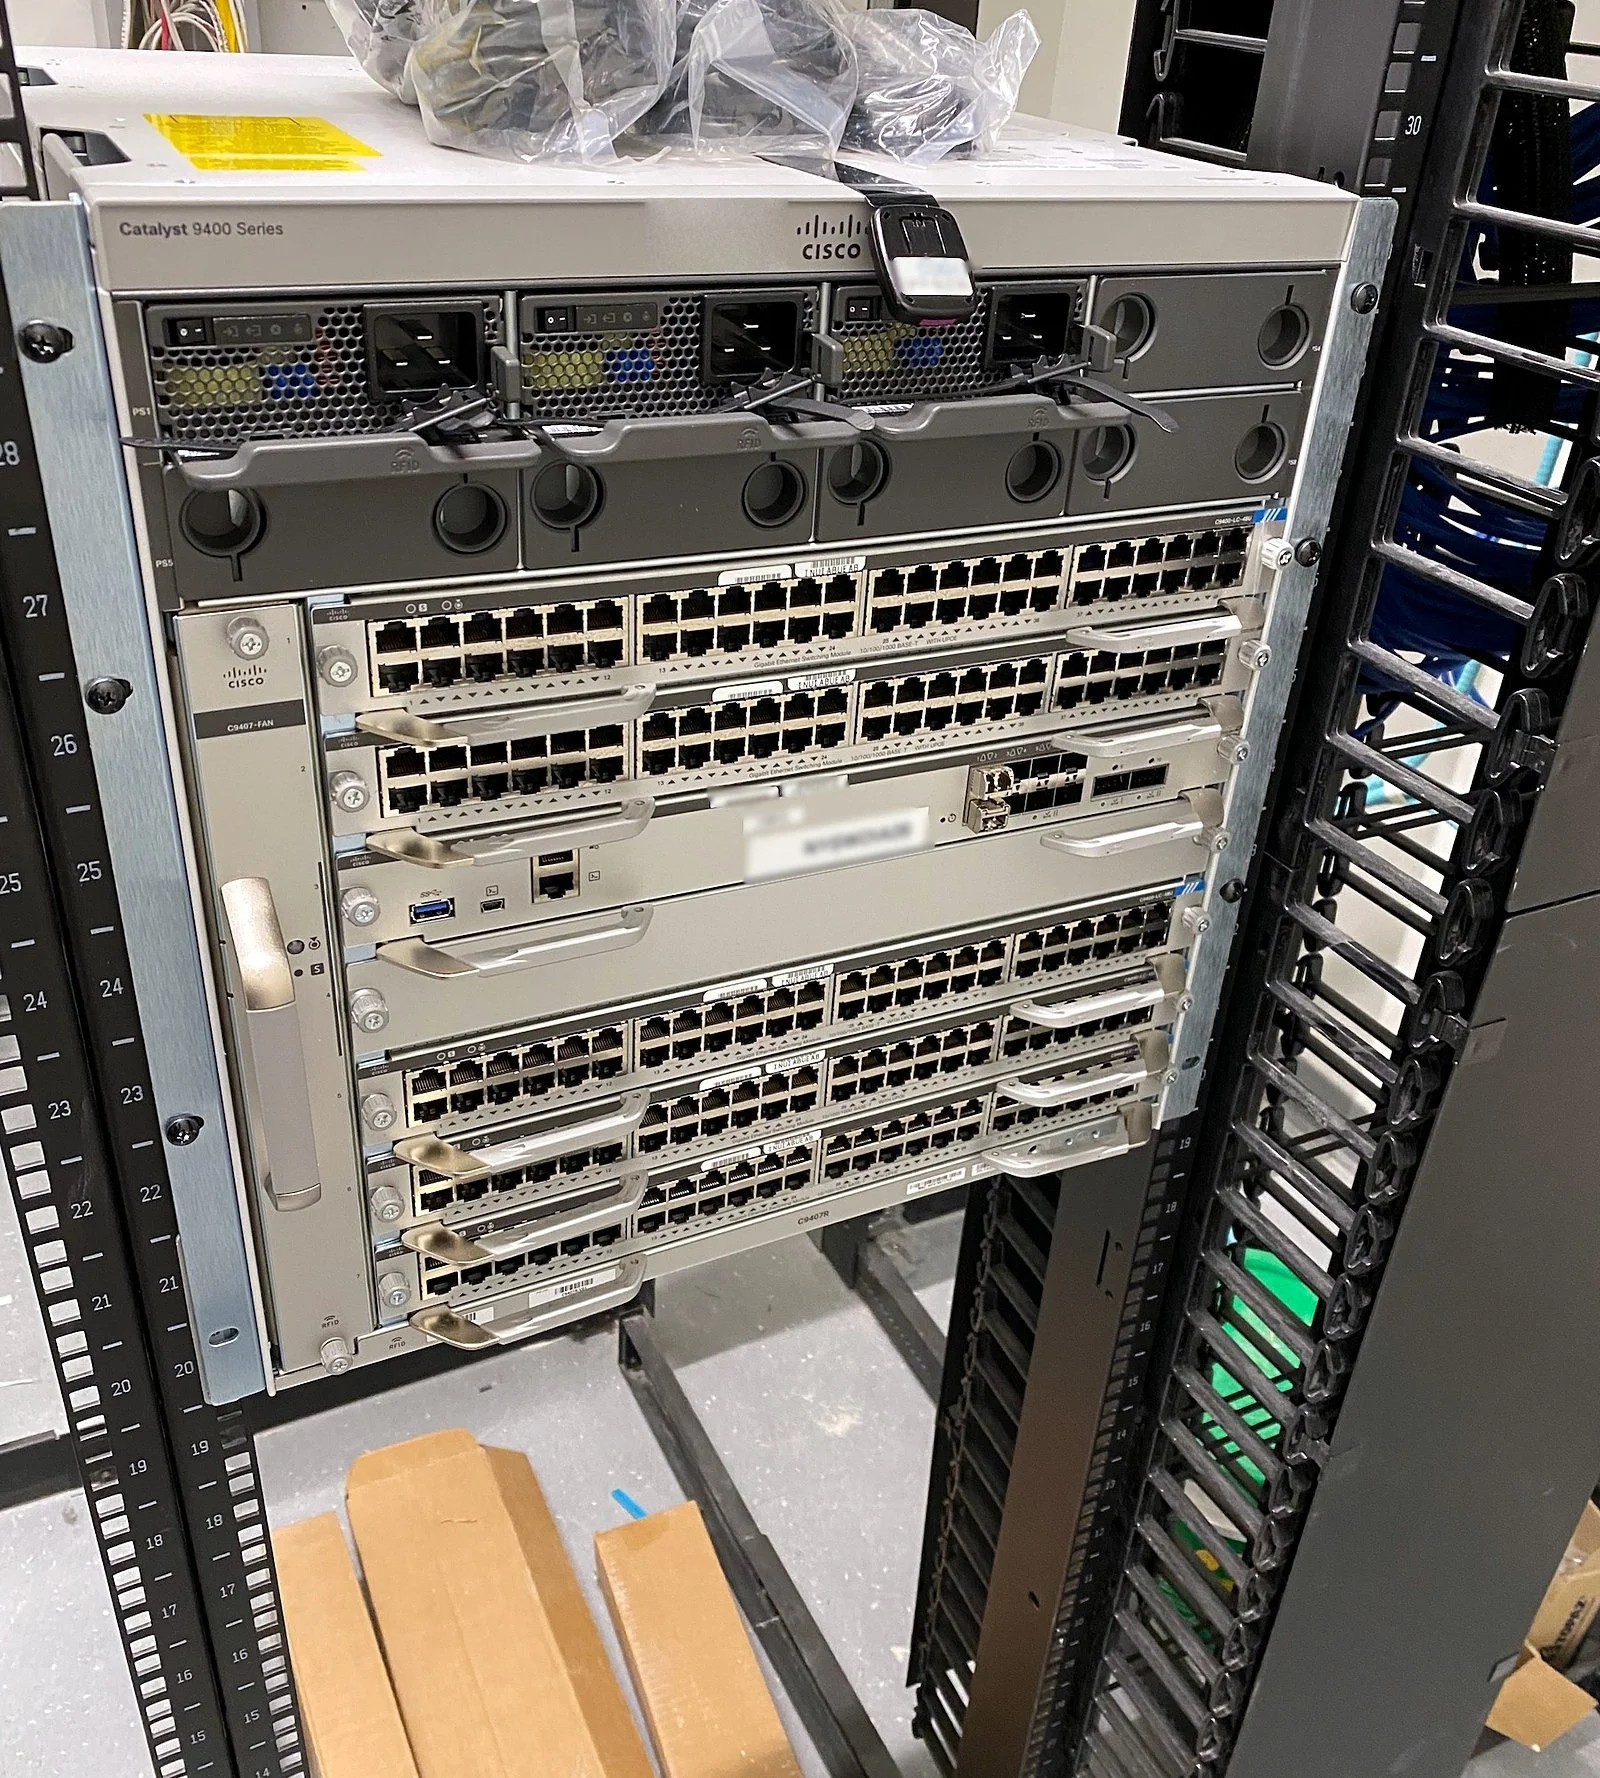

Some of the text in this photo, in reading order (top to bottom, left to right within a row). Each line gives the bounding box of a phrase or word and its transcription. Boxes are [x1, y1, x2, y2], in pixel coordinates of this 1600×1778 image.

[1404, 115, 1422, 136] 30
[119, 222, 284, 239] Catalyst 9400 Series
[802, 243, 861, 260] CISCO
[132, 407, 151, 416] PS1
[155, 559, 174, 568] PS5
[22, 594, 48, 618] 27
[329, 613, 348, 622] CISCO
[776, 656, 801, 665] Ethernet
[801, 653, 830, 663] Switching
[229, 677, 264, 689] CISCO
[227, 719, 274, 733] C9407-FAN
[50, 733, 78, 757] 26
[77, 861, 102, 882] 25
[0, 873, 22, 894] 25
[100, 977, 124, 998] 24
[23, 991, 48, 1012] 24
[120, 1085, 144, 1105] 23
[48, 1100, 72, 1120] 23
[1179, 1137, 1191, 1150] 19
[140, 1184, 162, 1203] 22
[70, 1200, 94, 1220] 22
[1165, 1201, 1177, 1214] 18
[798, 1210, 830, 1226] C9407R
[1152, 1262, 1164, 1274] 17
[159, 1275, 179, 1293] 21
[92, 1294, 112, 1312] 21
[321, 1319, 339, 1329] RFID
[1140, 1320, 1151, 1333] 16
[389, 1340, 406, 1350] RFID
[174, 1361, 194, 1378] 20
[111, 1379, 132, 1397] 20
[1128, 1376, 1139, 1388] 15
[191, 1440, 209, 1456] 19
[129, 1459, 147, 1476] 19
[205, 1514, 223, 1530] 18
[146, 1534, 164, 1550] 18
[220, 1583, 236, 1598] 17
[161, 1604, 177, 1619] 17
[232, 1648, 249, 1663] 16
[177, 1669, 193, 1684] 16
[243, 1709, 260, 1724] 15
[190, 1730, 206, 1745] 15
[255, 1767, 271, 1778] 14
